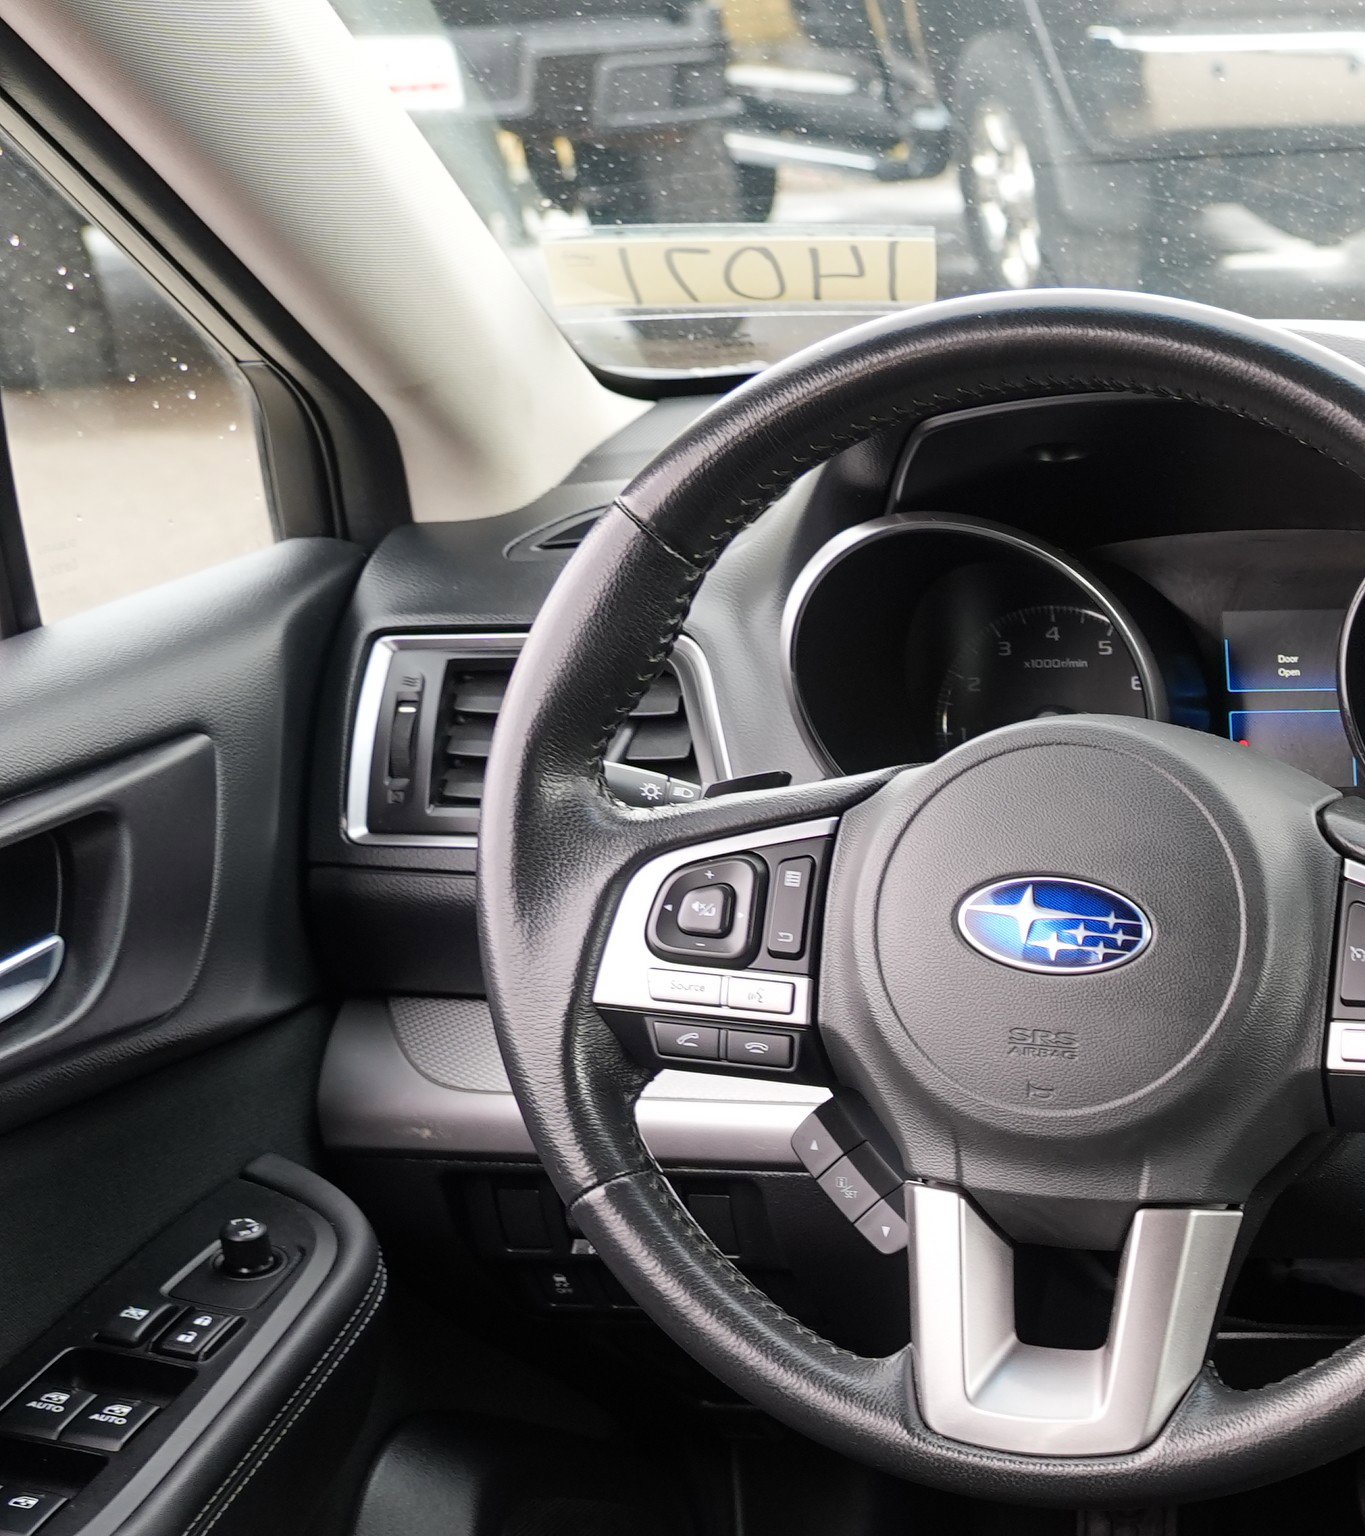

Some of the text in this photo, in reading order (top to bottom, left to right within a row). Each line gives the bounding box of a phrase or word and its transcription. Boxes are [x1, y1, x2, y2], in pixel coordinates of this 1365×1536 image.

[1045, 626, 1060, 641] 4
[998, 641, 1012, 656] 3
[1098, 640, 1113, 656] 5
[1278, 655, 1299, 663] Door
[1278, 668, 1300, 677] Open
[967, 677, 981, 692] 2
[670, 981, 706, 993] Source
[1007, 1027, 1078, 1046] SRS
[1007, 1046, 1079, 1060] AIRBAG
[26, 1401, 65, 1413] AUTO
[88, 1413, 127, 1425] AUTO
